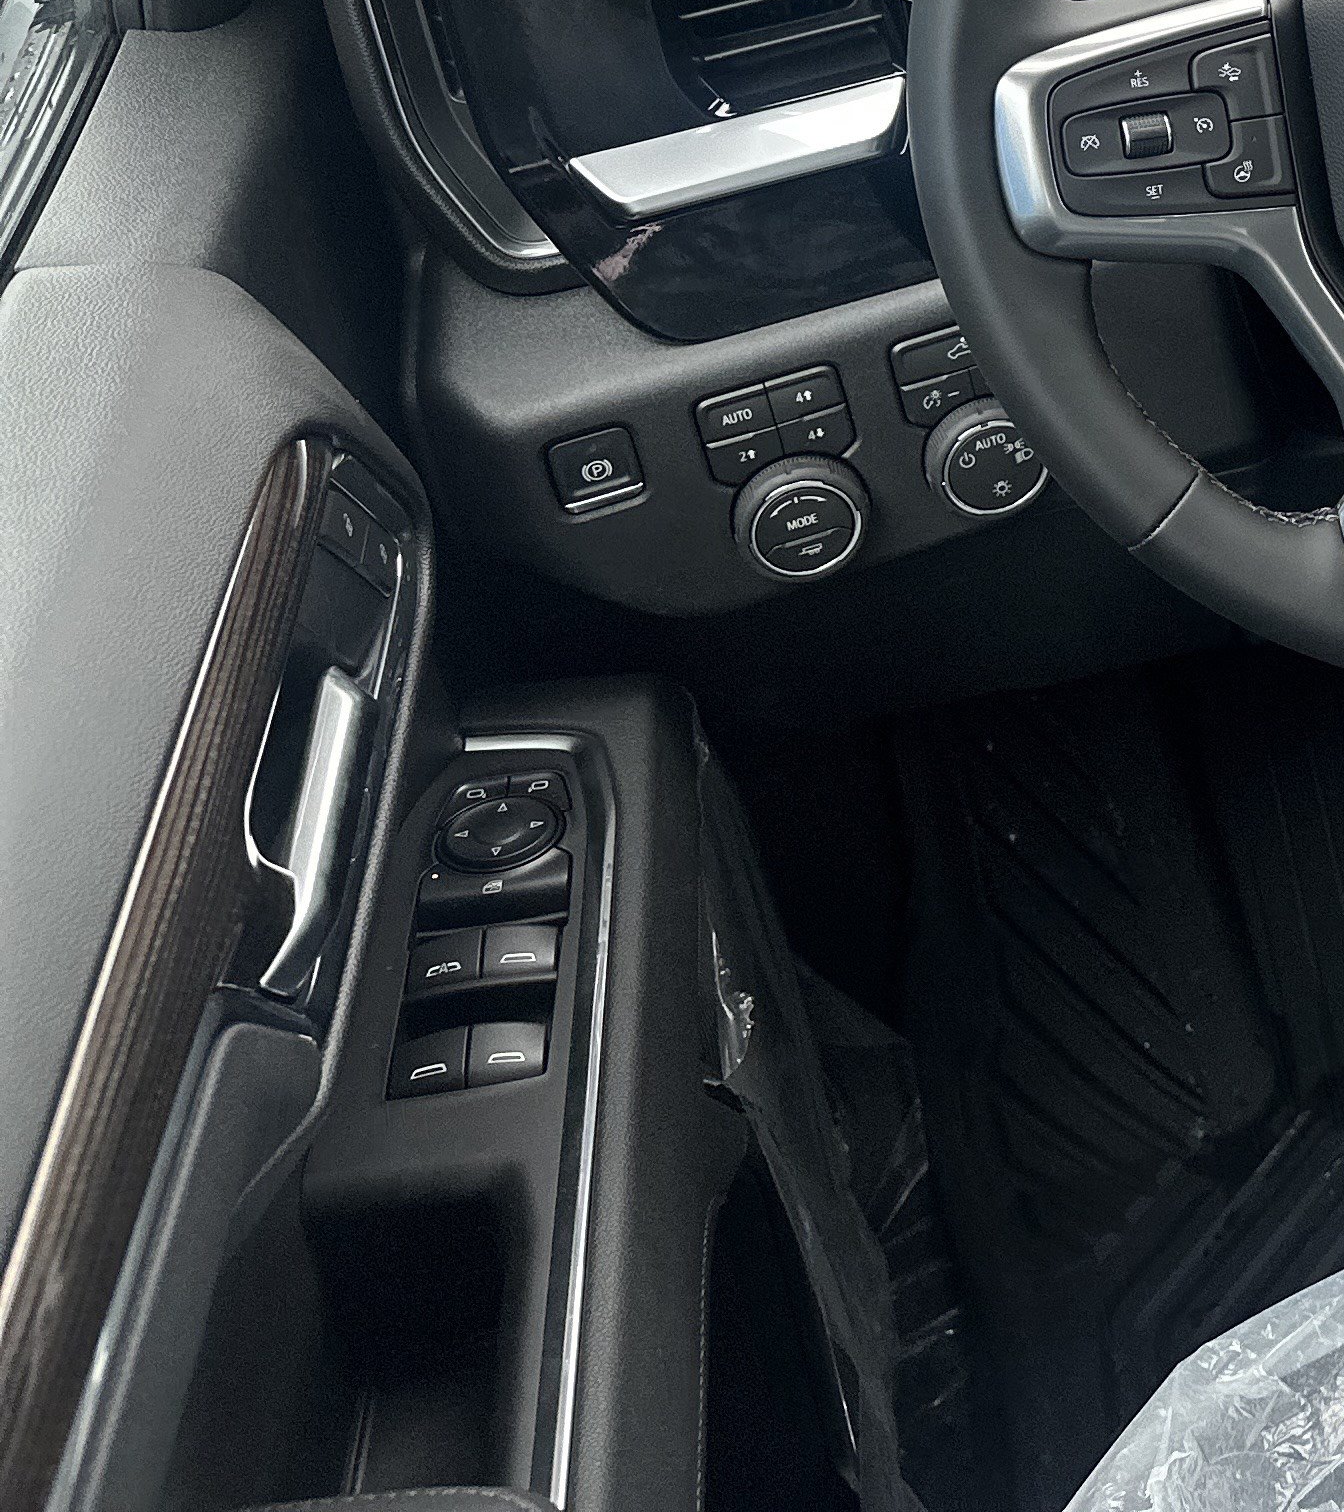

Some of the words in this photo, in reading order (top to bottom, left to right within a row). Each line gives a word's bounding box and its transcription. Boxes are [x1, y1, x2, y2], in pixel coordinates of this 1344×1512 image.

[1130, 77, 1149, 88] RES
[1146, 185, 1164, 197] SET
[721, 408, 753, 428] AUTO
[974, 433, 1007, 453] AUTO
[786, 512, 819, 531] MODE
